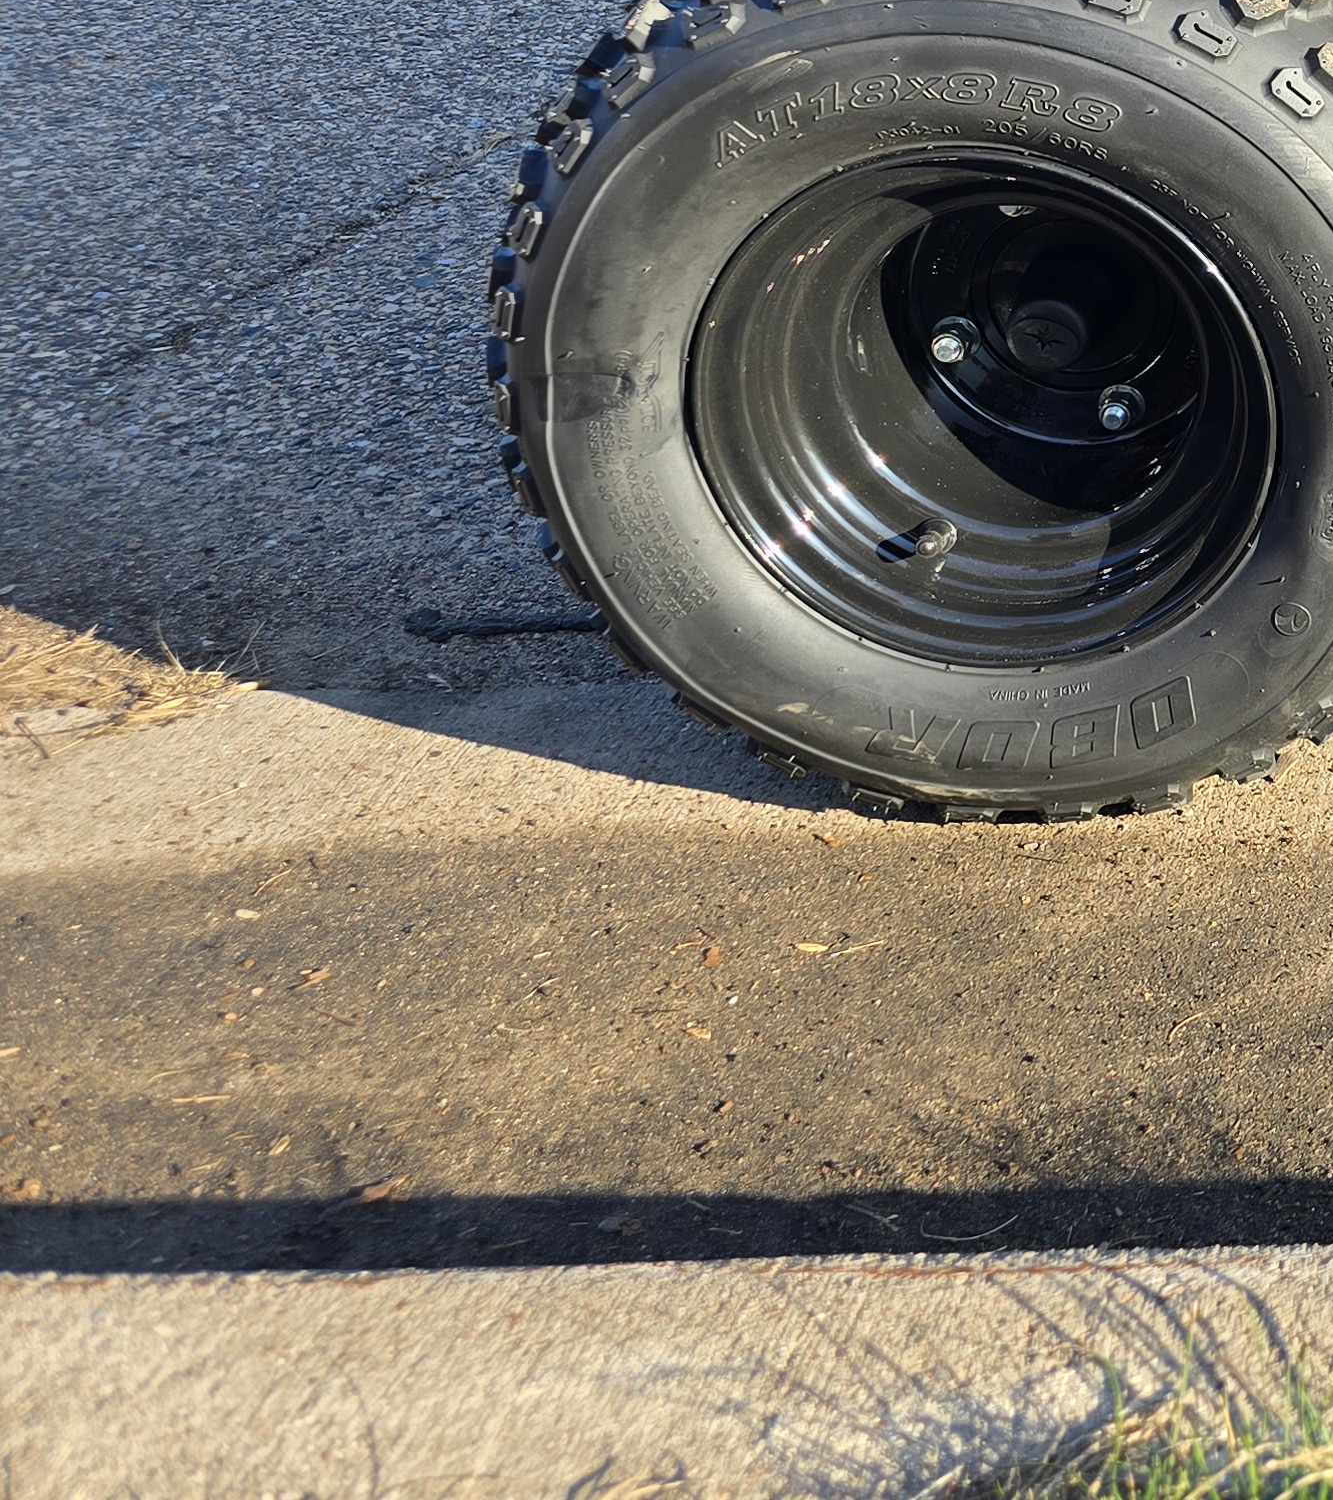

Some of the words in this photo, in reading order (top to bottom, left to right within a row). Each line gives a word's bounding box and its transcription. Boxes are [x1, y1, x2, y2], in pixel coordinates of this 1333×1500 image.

[1178, 196, 1210, 224] NOT
[1305, 262, 1330, 291] PLY
[597, 482, 614, 502] OR
[622, 455, 647, 505] BEYOND
[605, 505, 633, 546] LABEL
[637, 507, 674, 560] INFLATE
[656, 509, 695, 563] SEATING
[638, 539, 662, 566] FOR
[625, 546, 666, 596] VEHICLE
[668, 560, 693, 586] NOT
[688, 563, 721, 597] WHEN
[655, 565, 699, 613] MANUAL
[987, 688, 1030, 701] CHINA
[1051, 679, 1092, 697] MADE
